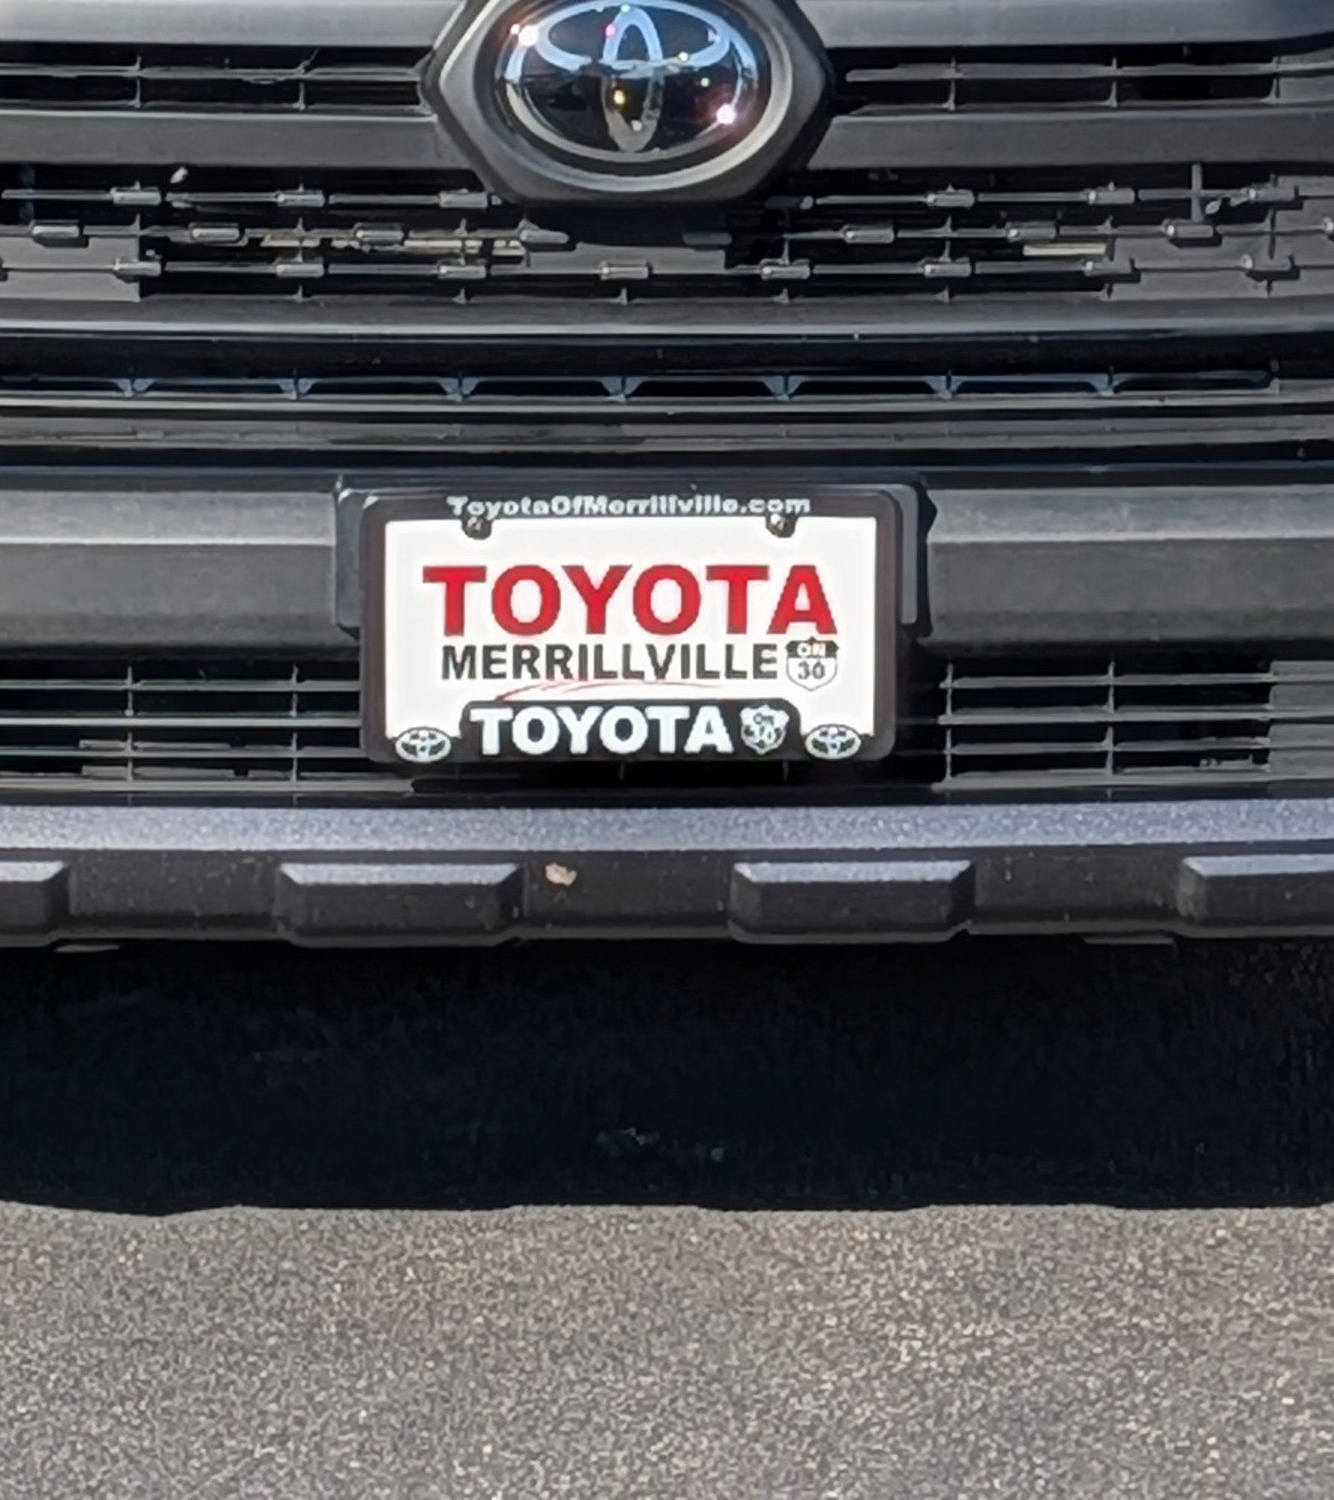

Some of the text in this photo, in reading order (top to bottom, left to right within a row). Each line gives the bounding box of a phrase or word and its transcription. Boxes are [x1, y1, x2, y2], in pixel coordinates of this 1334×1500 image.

[446, 495, 811, 518] ToyotaOfMerrillville.com
[422, 564, 838, 637] TOYOTA
[441, 643, 778, 681] MERRILLVILLE
[797, 642, 826, 657] ON
[797, 660, 826, 680] 30
[470, 705, 734, 755] TOYOTA
